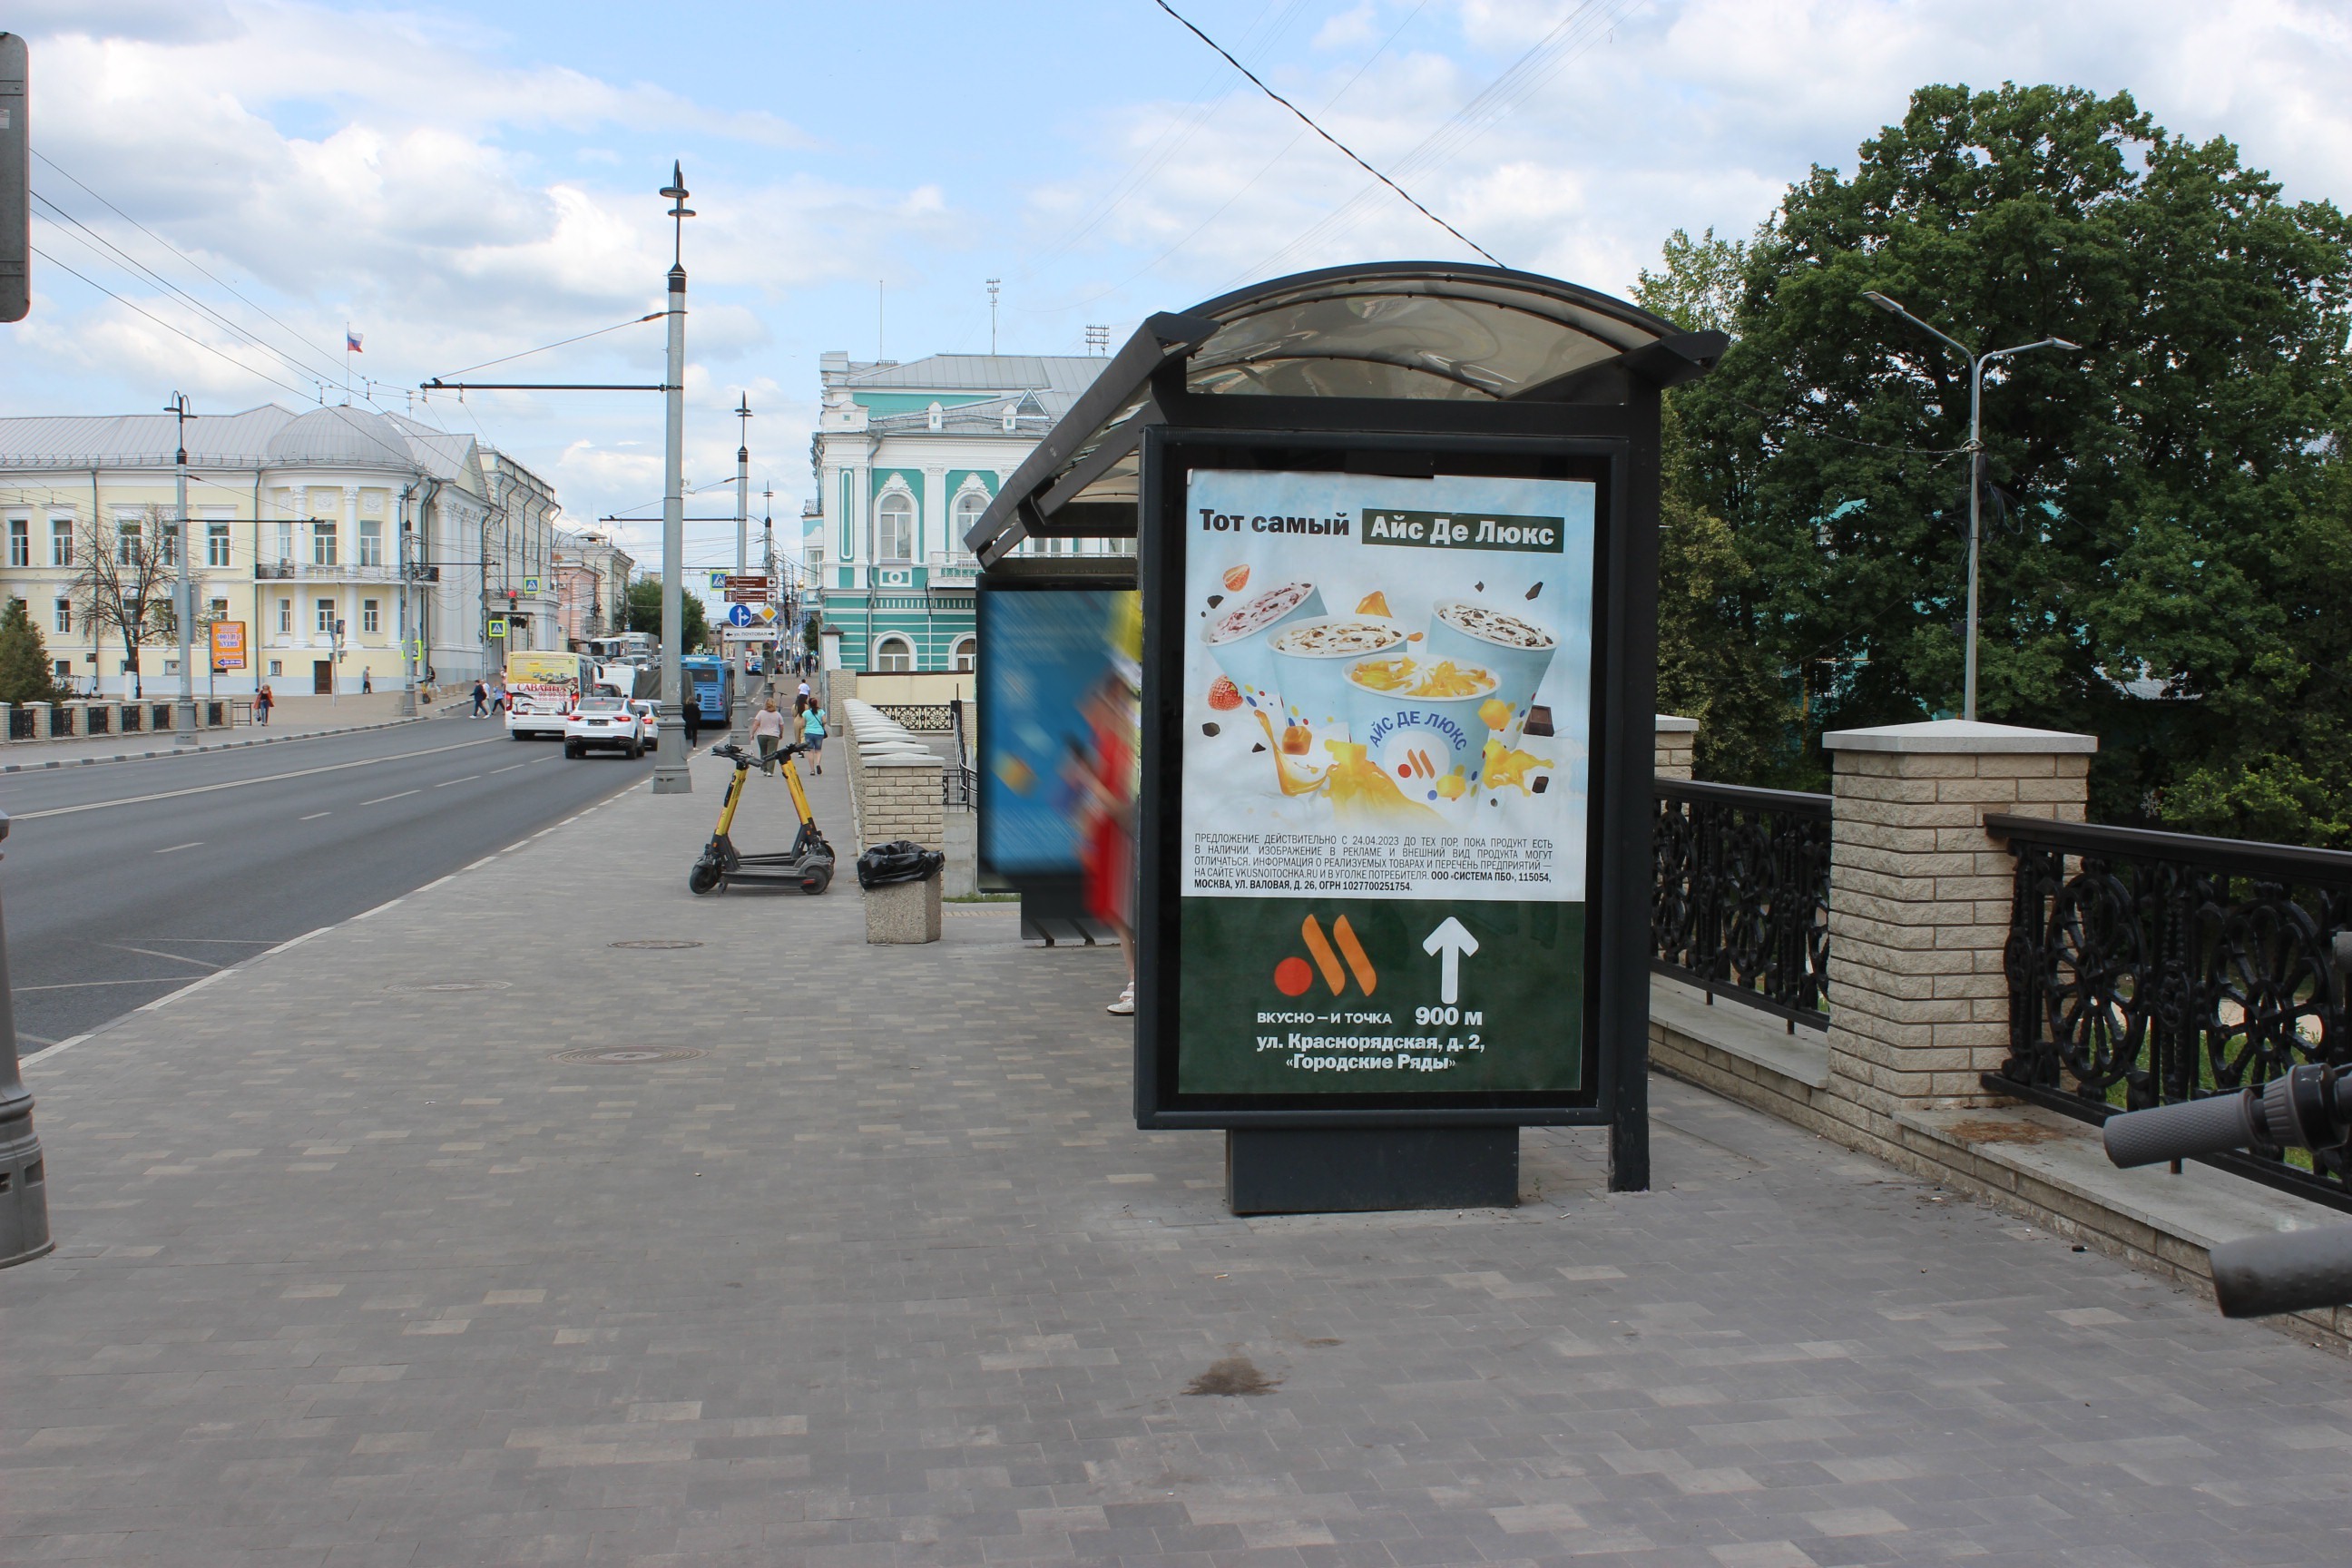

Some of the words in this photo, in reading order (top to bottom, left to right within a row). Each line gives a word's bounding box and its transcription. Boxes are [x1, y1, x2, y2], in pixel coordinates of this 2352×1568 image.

[1200, 509, 1244, 531] Тот
[1251, 513, 1349, 535] самый
[1370, 515, 1423, 539] Айс
[1430, 519, 1468, 544] Де
[1475, 521, 1554, 544] Люкс
[1369, 717, 1394, 748] АЙС
[1397, 711, 1420, 728] ДЕ
[1425, 713, 1466, 750] ЛЮКС
[1194, 834, 1259, 846] ПРЕДЛОЖЕНИЕ
[1264, 833, 1337, 847] ДЕЙСТВИТЕЛЬНО
[1341, 836, 1348, 846] С
[1352, 836, 1399, 846] 24.04.2023
[1404, 837, 1416, 848] ДО
[1421, 837, 1436, 847] ТЕХ
[1441, 838, 1458, 848] ПОР,
[1464, 838, 1486, 848] ПОКА
[1491, 838, 1527, 849] ПРОДУКТ
[1533, 838, 1553, 848] ЕСТЬ
[1195, 845, 1200, 854] В
[1208, 846, 1251, 855] НАЛИЧИИ.
[1259, 847, 1322, 856] ИЗОБРАЖЕНИЕ
[1329, 847, 1336, 856] В
[1343, 848, 1382, 857] РЕКЛАМЕ
[1389, 848, 1396, 857] И
[1402, 847, 1446, 858] ВНЕШНИЙ
[1453, 848, 1470, 860] ВИД
[1477, 849, 1518, 860] ПРОДУКТА
[1524, 850, 1553, 859] МОГУТ
[1194, 857, 1250, 866] ОТЛИЧАТЬСЯ.
[1252, 858, 1313, 868] ИНФОРМАЦИЯ
[1316, 858, 1322, 867] О
[1324, 858, 1387, 867] РЕАЛИЗУЕМЫХ
[1389, 859, 1424, 868] ТОВАРАХ
[1426, 860, 1433, 869] И
[1435, 860, 1478, 869] ПЕРЕЧЕНЬ
[1481, 859, 1541, 872] ПРЕДПРИЯТИЙ
[1194, 867, 1206, 877] НА
[1207, 867, 1234, 877] САЙТЕ
[1236, 868, 1318, 877] VKUSNOITOCHKA.RU
[1319, 869, 1326, 878] И
[1328, 869, 1334, 878] В
[1335, 870, 1367, 879] УГОЛКЕ
[1368, 870, 1430, 879] ПОТРЕБИТЕЛЯ.
[1431, 871, 1449, 880] ООО
[1519, 873, 1552, 884] 115054,
[1194, 879, 1232, 890] МОСКВА,
[1235, 880, 1248, 889] УЛ.
[1250, 880, 1292, 891] ВАЛОВАЯ,
[1294, 881, 1302, 891] Д.
[1305, 881, 1318, 892] 26,
[1319, 881, 1341, 890] ОГРН
[1343, 882, 1413, 891] 1027700251754.
[1257, 1012, 1315, 1024] ВКУСНО
[1331, 1013, 1340, 1024] И
[1345, 1013, 1392, 1024] ТОЧКА
[1416, 1007, 1459, 1025] 900
[1465, 1012, 1482, 1025] м
[1256, 1036, 1283, 1052] ул.
[1289, 1033, 1443, 1053] Краснорядская,
[1446, 1038, 1465, 1053] д.
[1468, 1034, 1485, 1053] 2,
[1287, 1054, 1393, 1072] «Городские
[1397, 1054, 1455, 1072] Ряды»
